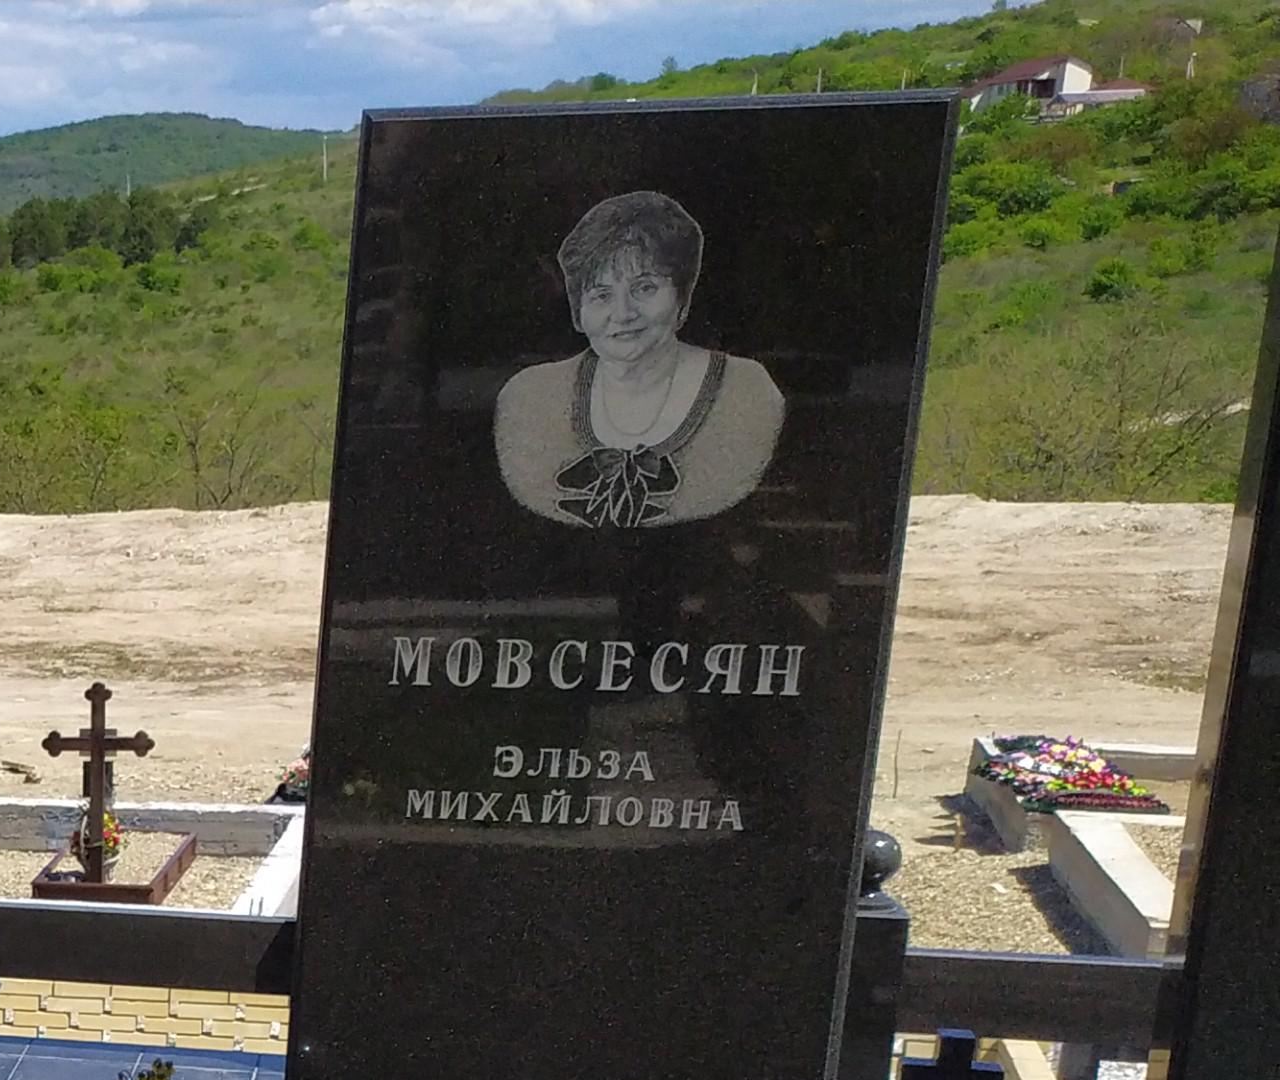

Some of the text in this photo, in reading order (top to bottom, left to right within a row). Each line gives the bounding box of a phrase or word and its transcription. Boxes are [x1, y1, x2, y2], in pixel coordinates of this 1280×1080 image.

[389, 637, 806, 696] МОВСЕСЯН
[492, 745, 656, 782] ЭЛЬЗА
[405, 789, 745, 831] МИХАЙЛОВНА
